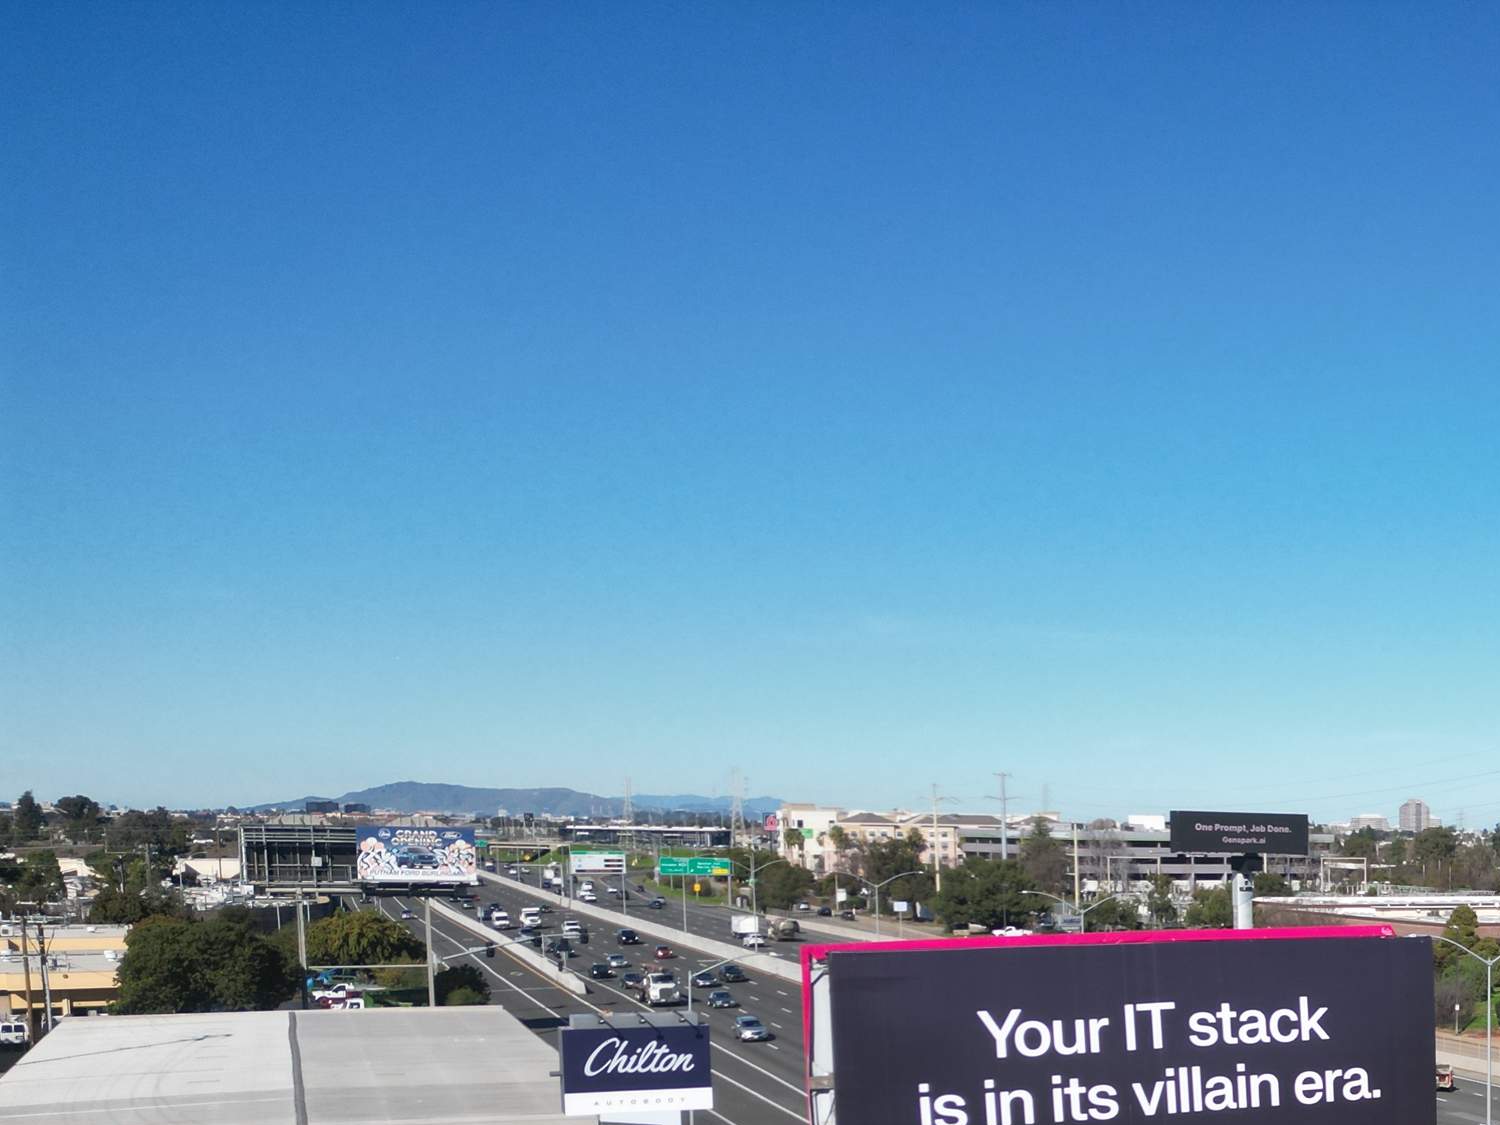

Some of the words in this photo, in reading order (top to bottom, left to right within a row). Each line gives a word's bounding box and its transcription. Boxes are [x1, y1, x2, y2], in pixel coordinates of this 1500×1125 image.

[1195, 823, 1213, 831] One
[1214, 823, 1249, 833] Prompt,
[1250, 824, 1266, 832] Job
[1267, 825, 1292, 833] Done.
[395, 829, 437, 838] GRAND
[391, 837, 443, 846] OPENING
[1222, 836, 1266, 844] Genspark.ai
[977, 1008, 1109, 1058] Your
[1124, 1001, 1175, 1051] IT
[1188, 996, 1330, 1047] stack
[584, 1037, 695, 1077] Chilton
[1051, 1075, 1120, 1123] its
[1132, 1063, 1280, 1116] villain
[1293, 1065, 1382, 1104] era.
[594, 1097, 685, 1106] AUTOBODY
